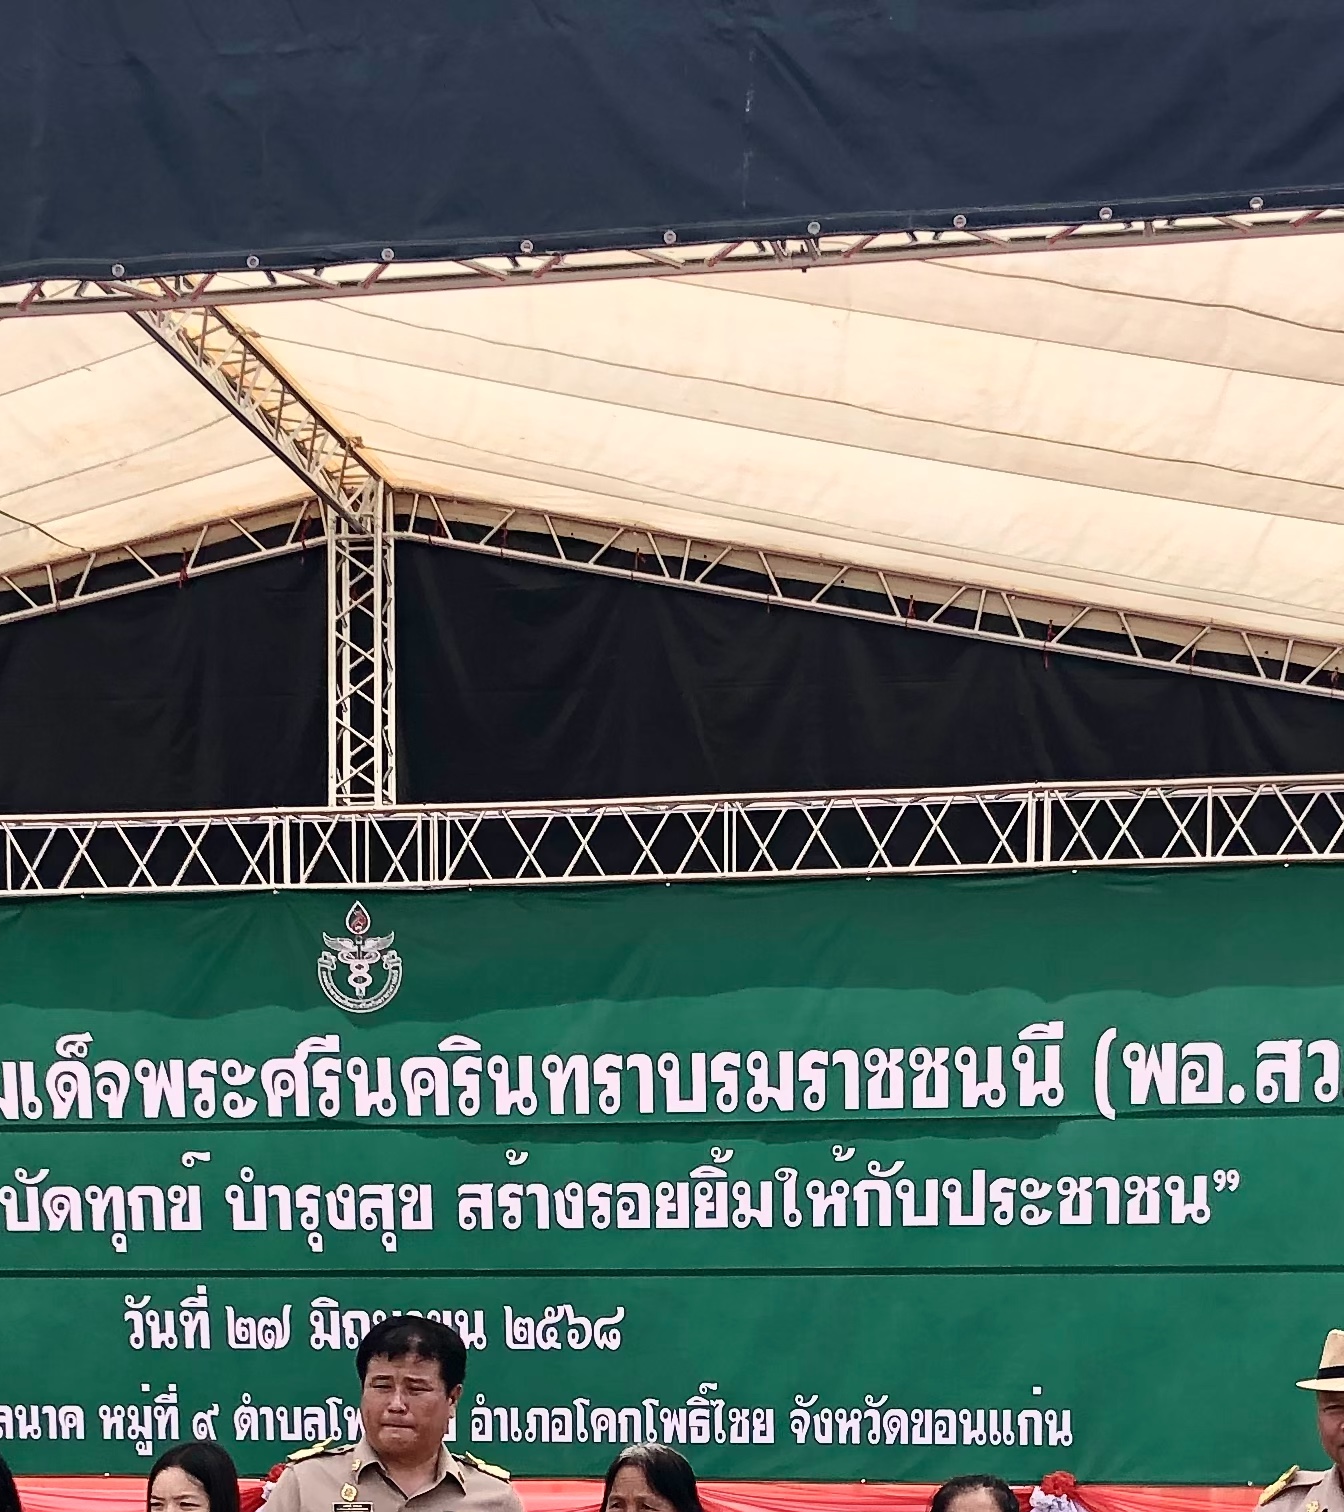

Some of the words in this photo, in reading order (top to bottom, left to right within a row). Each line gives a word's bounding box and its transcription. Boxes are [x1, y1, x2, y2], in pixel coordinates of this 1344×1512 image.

[225, 1167, 432, 1252] บำรุงสุข
[458, 1145, 1239, 1230] สร้างรอยยิ้มให้กับประชาชน”
[125, 1285, 210, 1349] วันที่
[226, 1304, 291, 1349] ๒๗
[504, 1304, 624, 1350] ๒๕๖๘
[99, 1384, 179, 1455] หมู่ที่
[470, 1382, 775, 1445] อำเภอโคกโพธิ์ไชย
[790, 1387, 1072, 1446] จังหวัดขอนแก่น
